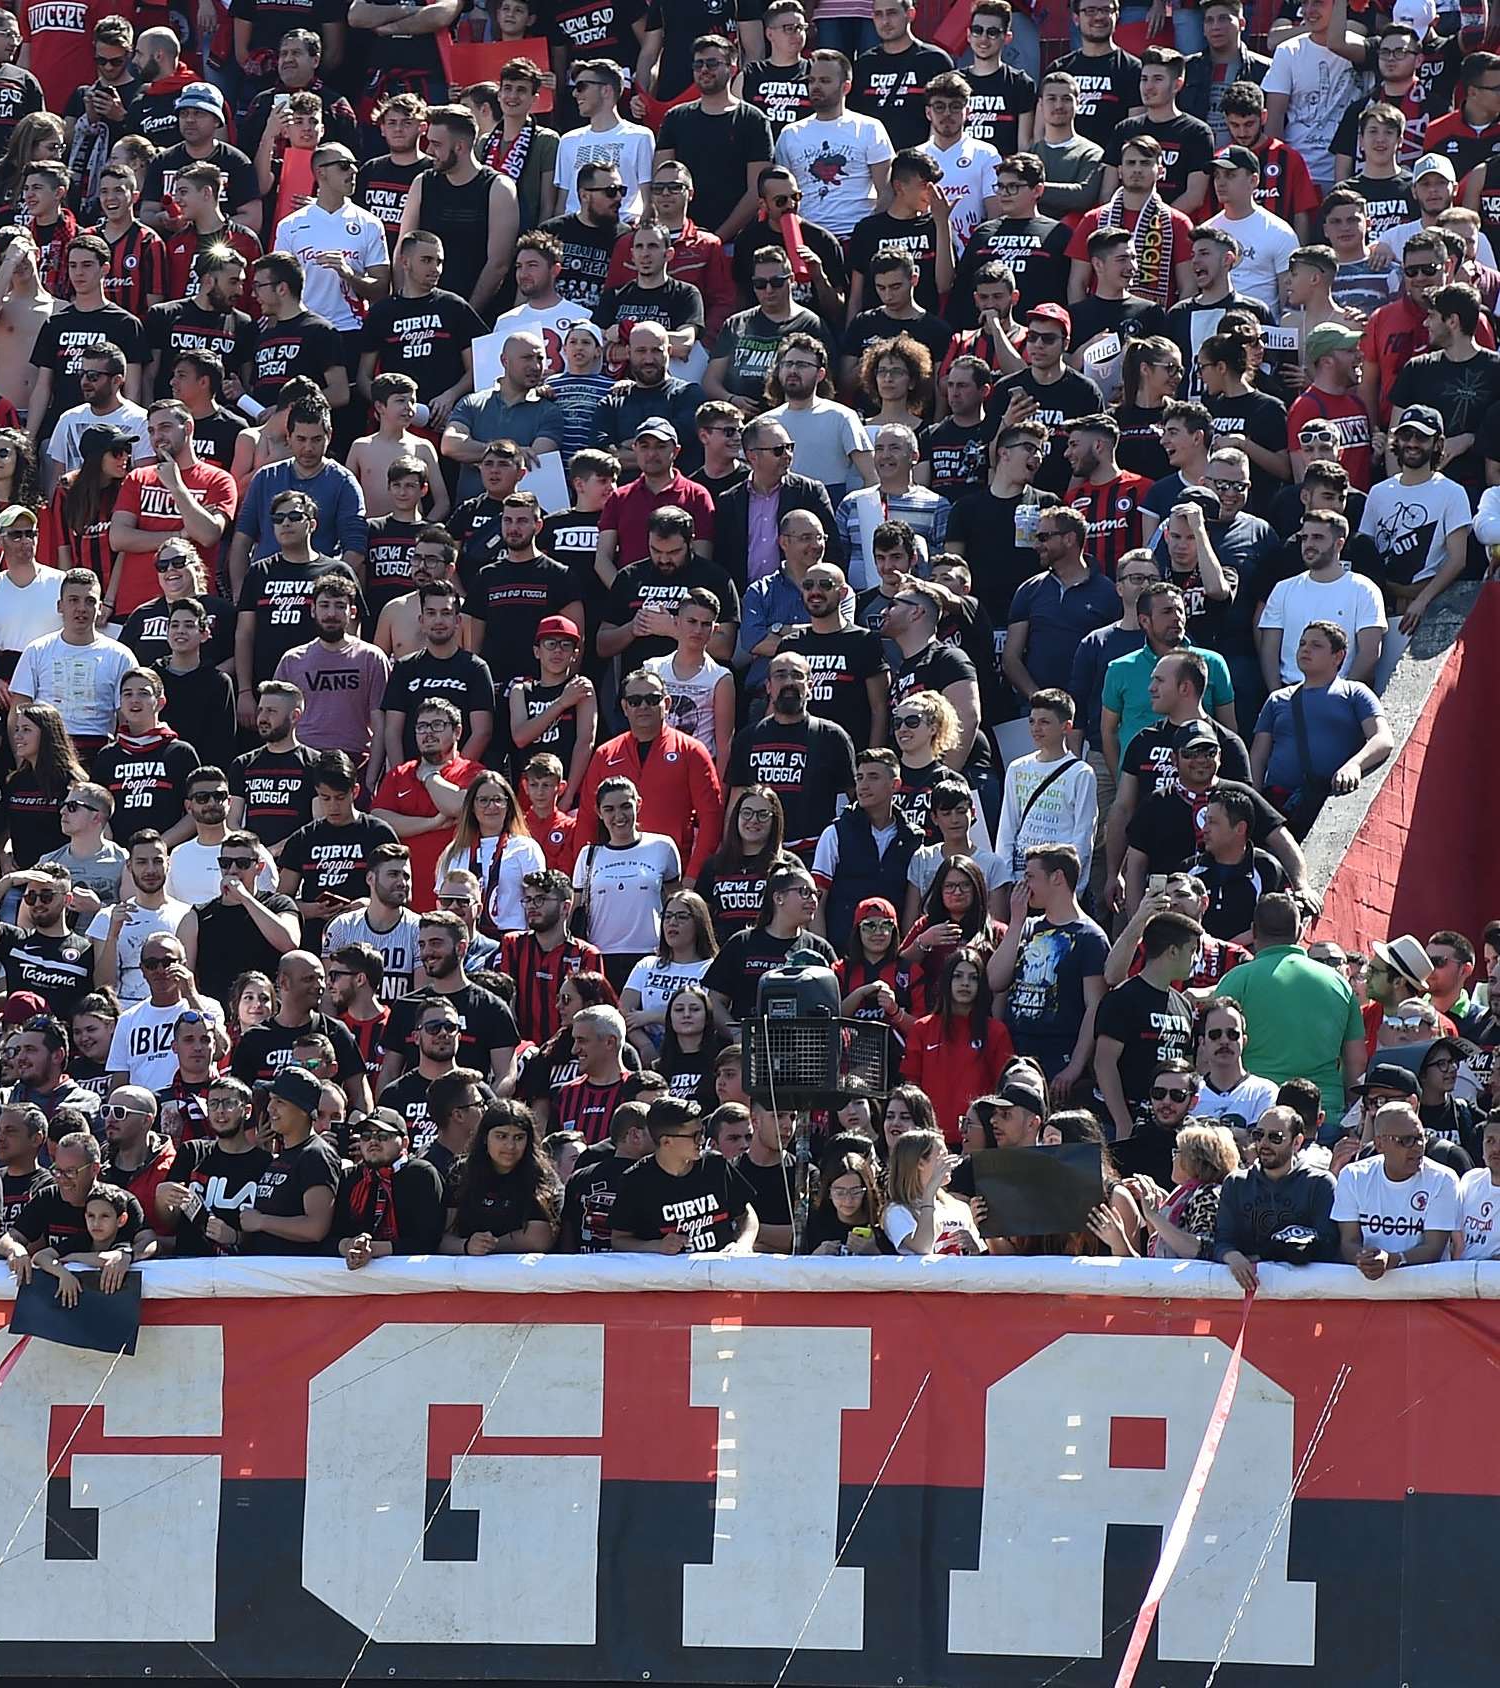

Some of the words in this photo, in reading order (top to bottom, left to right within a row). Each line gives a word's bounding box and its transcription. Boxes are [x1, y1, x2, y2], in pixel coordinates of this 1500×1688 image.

[759, 82, 808, 97] CURVA
[767, 107, 797, 123] SUD
[140, 116, 177, 135] Tamm
[988, 234, 1041, 249] CURVA
[392, 314, 442, 333] CURVA
[170, 332, 206, 351] CURVA
[210, 335, 235, 354] SUD
[1394, 533, 1418, 555] OUT
[264, 581, 314, 595] CURVA
[638, 585, 690, 599] CURVA
[270, 608, 301, 624] SUD
[304, 669, 361, 692] VANS
[750, 752, 785, 767] CURVA
[114, 761, 166, 778] CURVA
[758, 767, 801, 783] FOGGIA
[121, 776, 157, 790] Foggia
[244, 778, 275, 792] CURVA
[278, 778, 301, 791] SUD
[124, 792, 152, 809] SUD
[250, 791, 289, 805] FOGGIA
[311, 844, 363, 860] CURVA
[316, 857, 354, 871] Foggia
[318, 871, 348, 886] SUD
[19, 963, 76, 988] Tamma
[646, 971, 698, 990] PERFEC
[130, 1023, 175, 1056] IBIZ
[662, 1194, 719, 1223] CURVA
[676, 1212, 714, 1234] Foggia
[1358, 1212, 1425, 1236] FOGGIA
[685, 1231, 717, 1253] SUD
